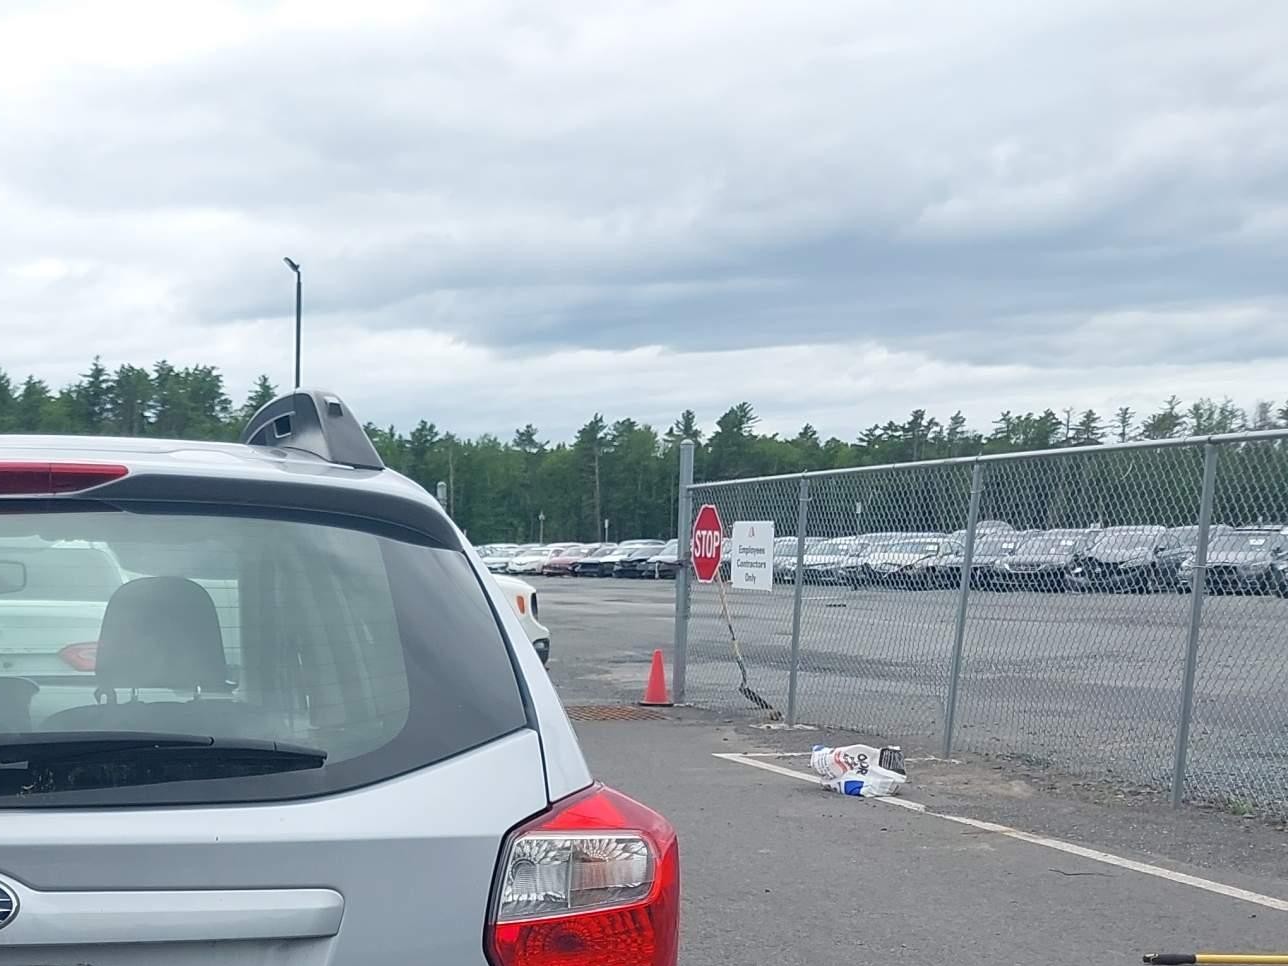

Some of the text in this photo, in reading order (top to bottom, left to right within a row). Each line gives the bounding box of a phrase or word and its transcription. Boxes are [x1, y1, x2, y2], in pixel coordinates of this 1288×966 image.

[695, 530, 720, 558] STOP
[737, 559, 766, 569] Contractors
[745, 573, 756, 584] Only
